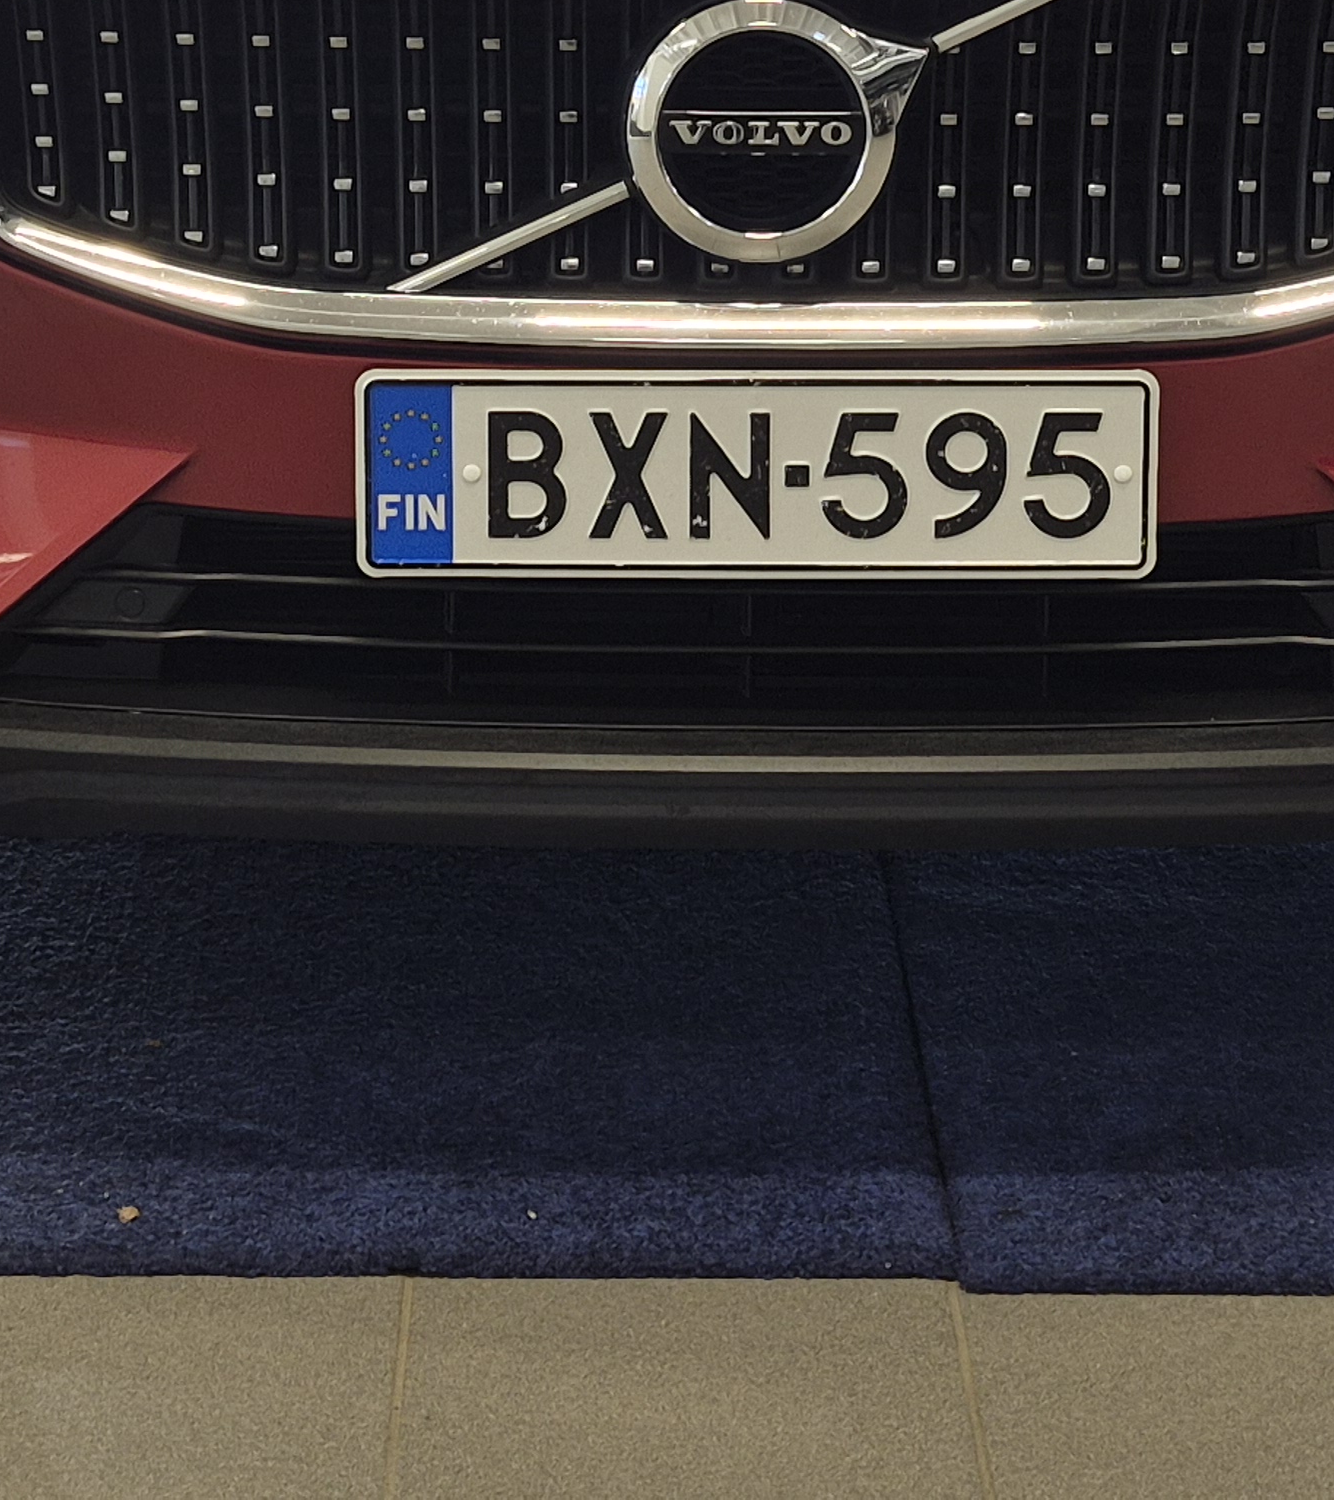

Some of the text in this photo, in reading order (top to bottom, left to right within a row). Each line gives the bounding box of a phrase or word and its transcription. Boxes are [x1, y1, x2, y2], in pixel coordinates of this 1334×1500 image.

[669, 120, 852, 147] VOLVO
[378, 410, 1112, 540] FIN BXN-595
